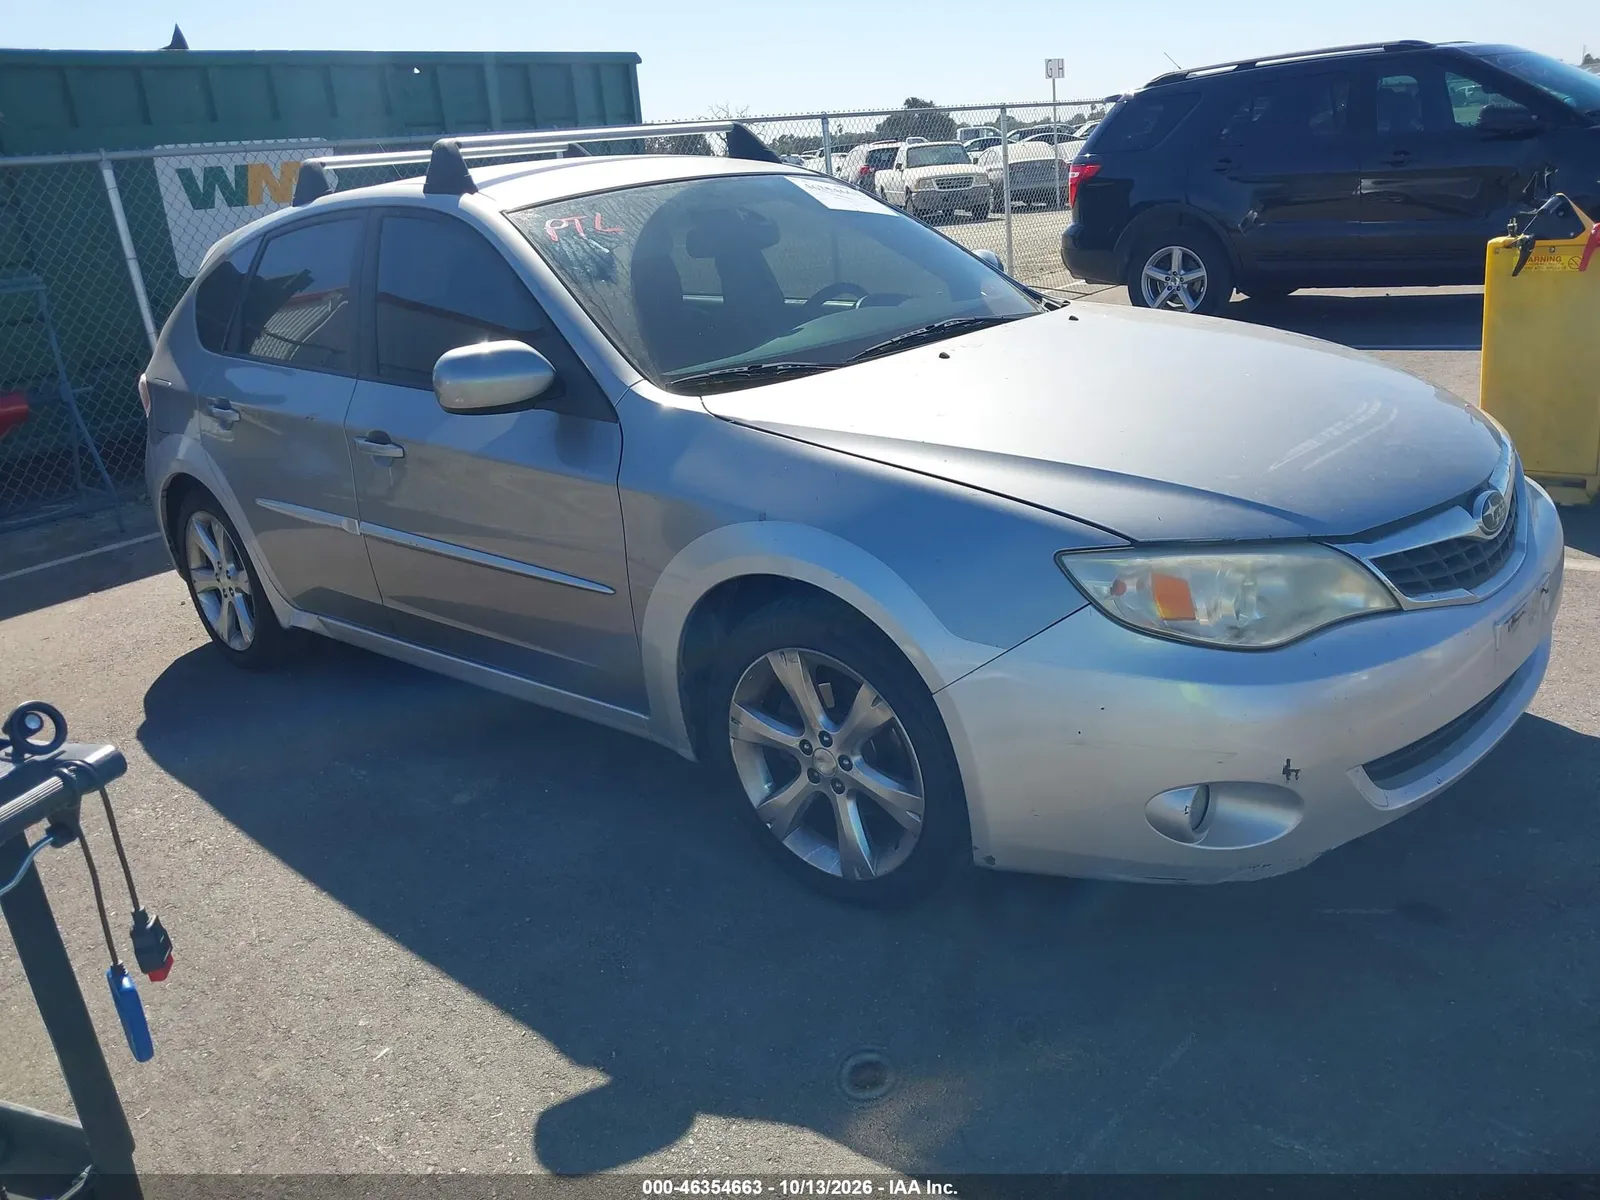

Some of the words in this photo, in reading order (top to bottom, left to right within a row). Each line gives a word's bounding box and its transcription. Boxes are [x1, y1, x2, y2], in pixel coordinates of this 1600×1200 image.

[1046, 59, 1053, 78] G
[1057, 59, 1064, 78] H
[543, 211, 625, 241] PTL
[1527, 255, 1562, 263] ARNING
